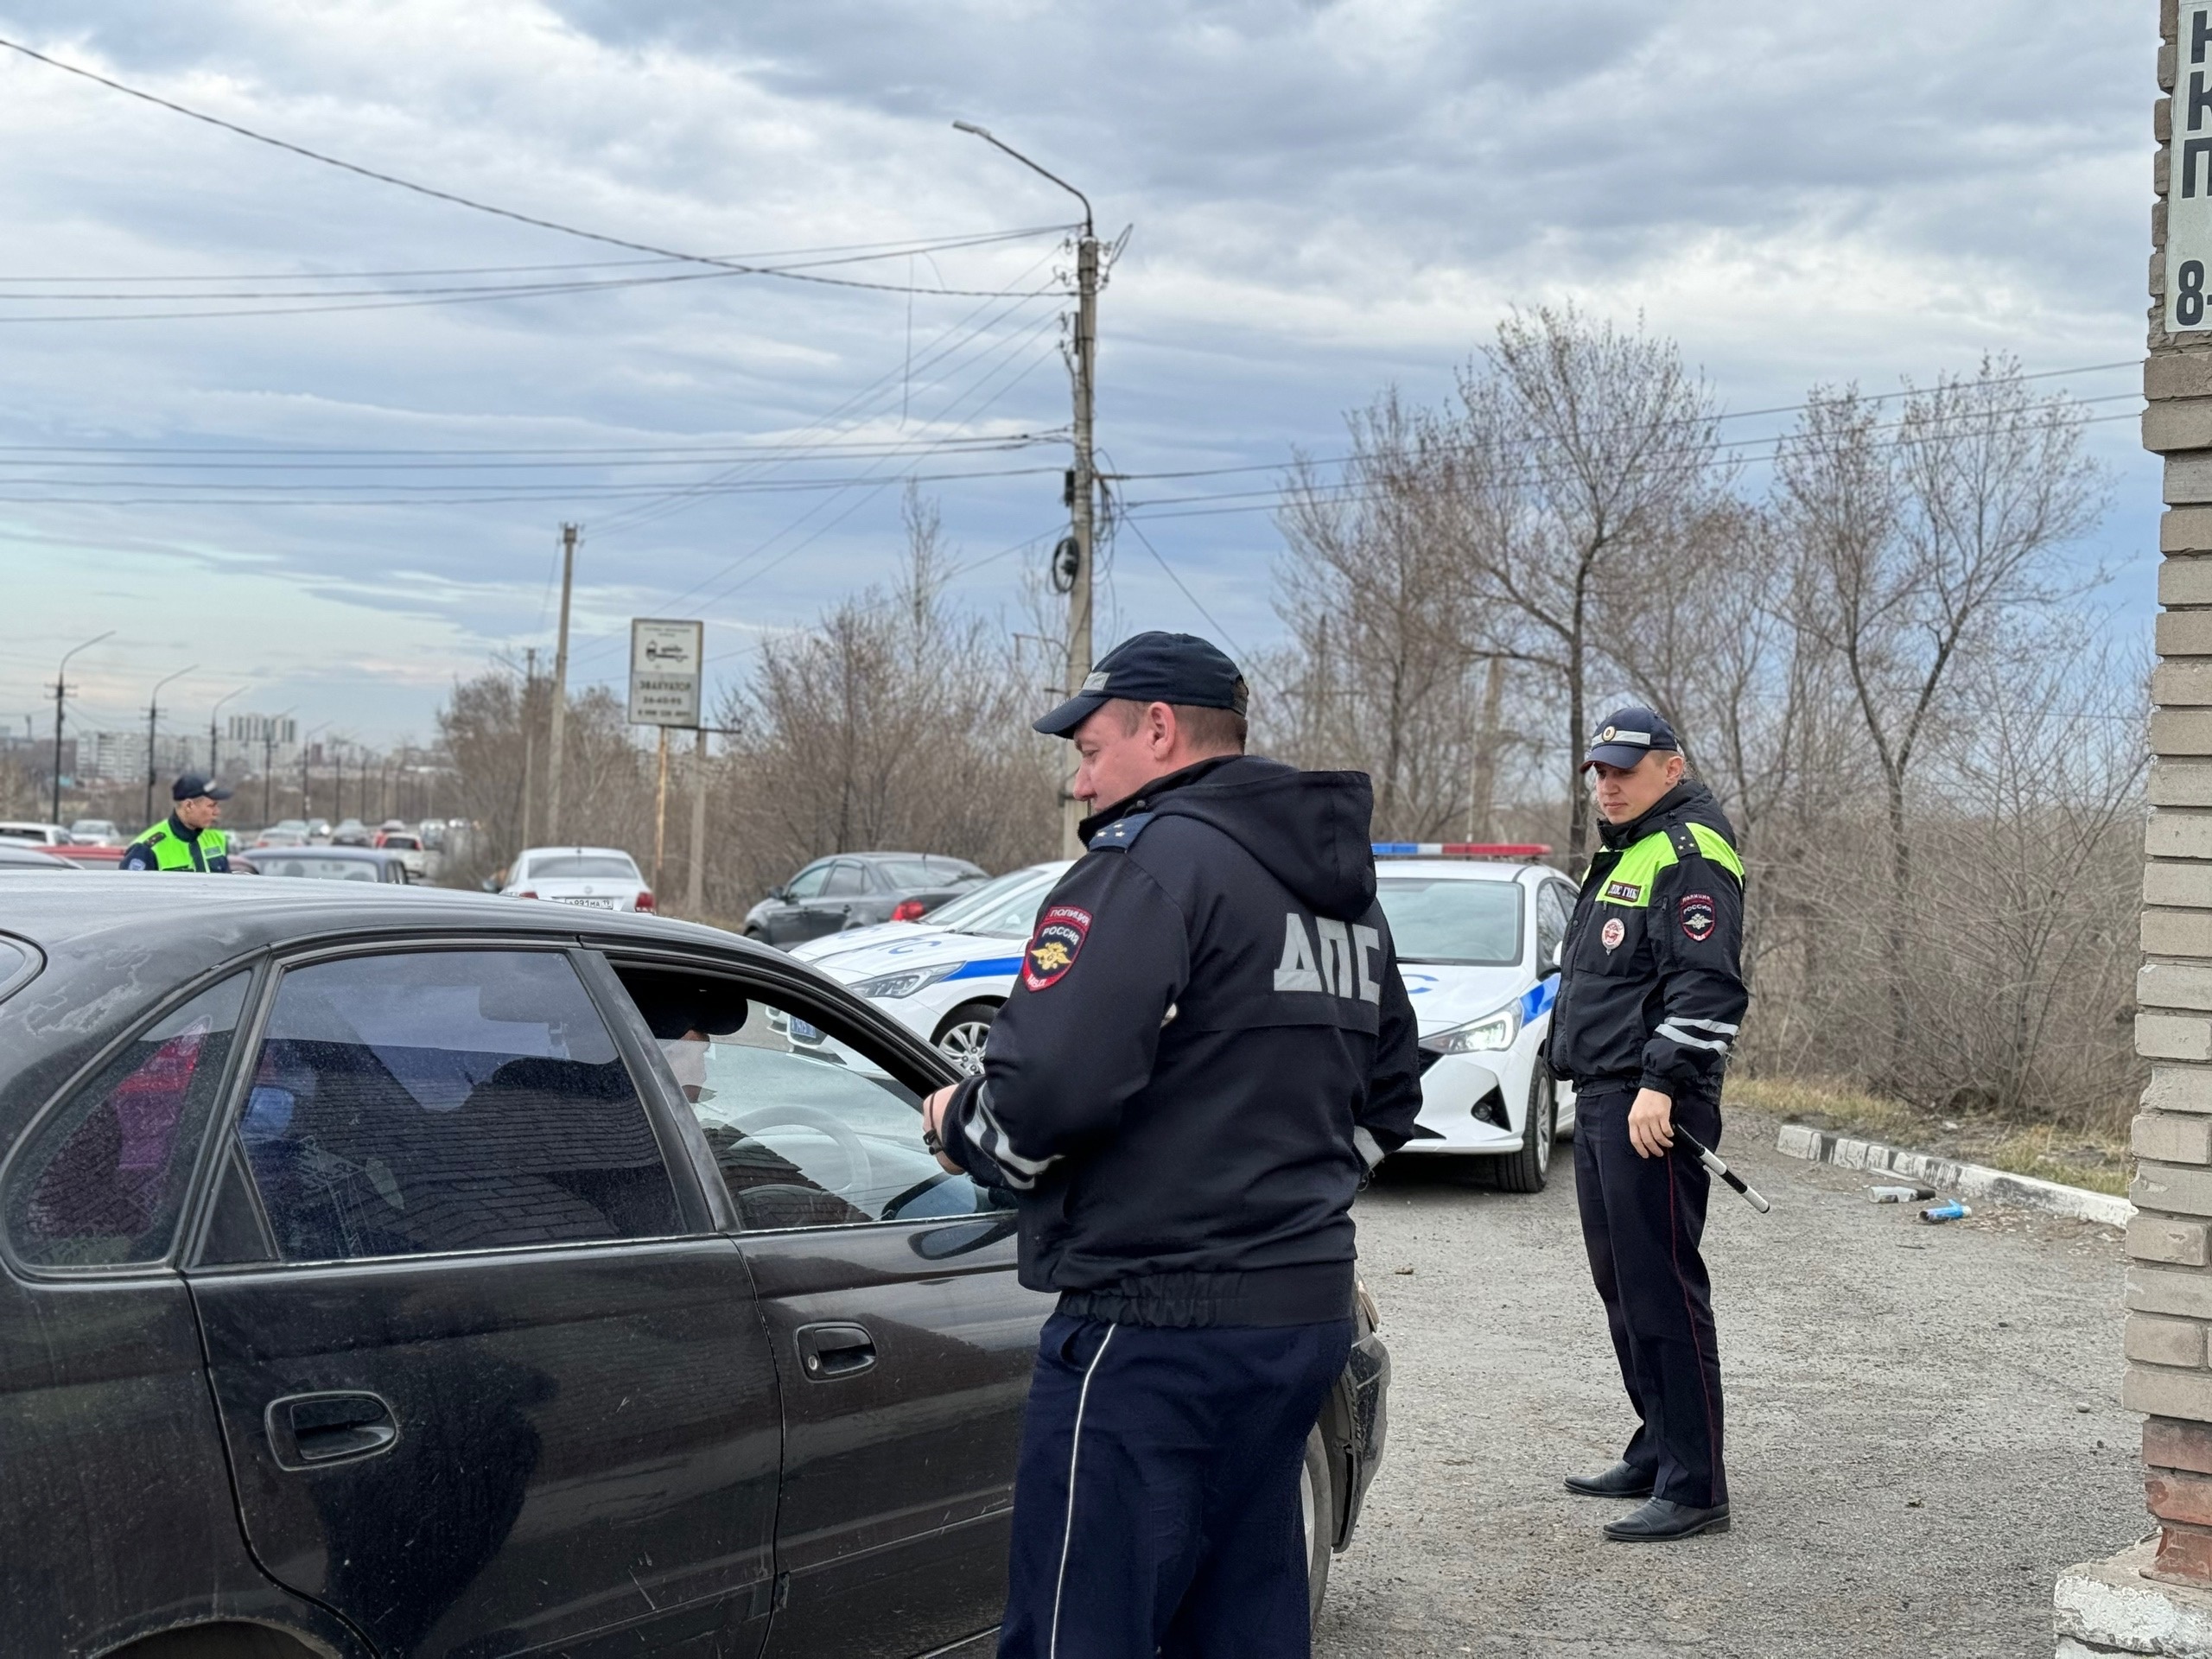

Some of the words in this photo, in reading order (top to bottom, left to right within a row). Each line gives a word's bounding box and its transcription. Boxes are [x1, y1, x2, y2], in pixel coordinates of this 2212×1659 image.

[1681, 893, 1711, 903] ПОЛИЦИЯ
[1049, 908, 1090, 926] ПОЛИЦИЯ
[1683, 904, 1712, 915] РОССИЯ
[1042, 926, 1080, 945] РОССИЯ
[1273, 912, 1381, 1006] ДПС
[1027, 973, 1048, 988] МВД
